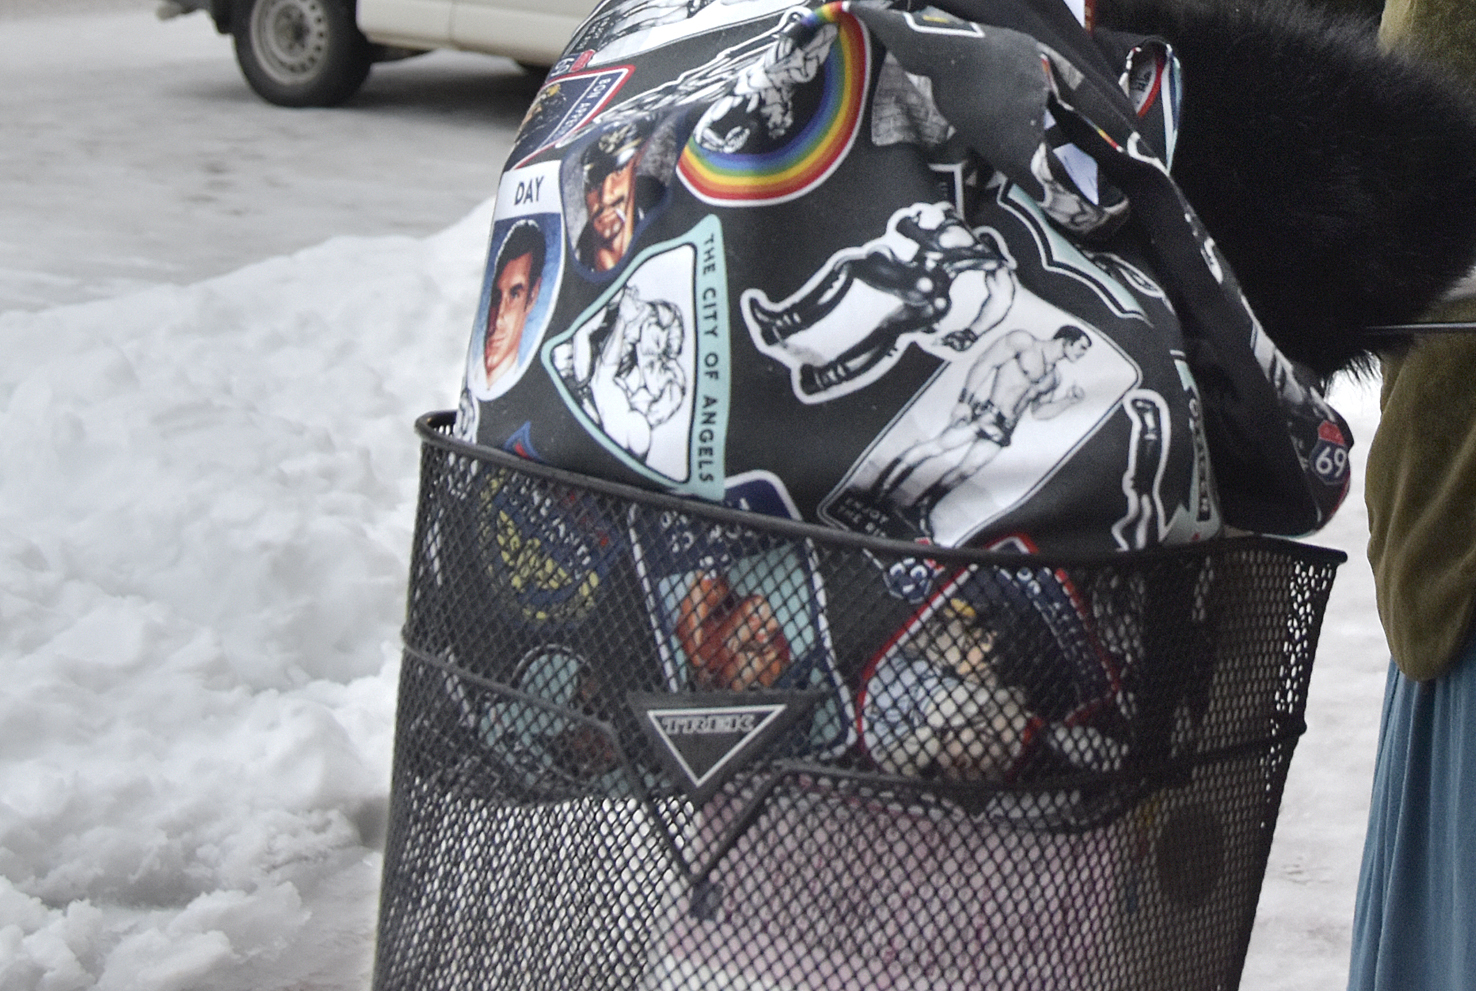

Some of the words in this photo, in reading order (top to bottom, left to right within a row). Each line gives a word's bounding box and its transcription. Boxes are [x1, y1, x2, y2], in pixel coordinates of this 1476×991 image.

[514, 175, 545, 206] DAY
[703, 233, 716, 275] THE
[702, 287, 718, 337] CITY
[703, 352, 719, 380] OF
[698, 395, 718, 482] ANGELS
[1316, 446, 1348, 478] 69
